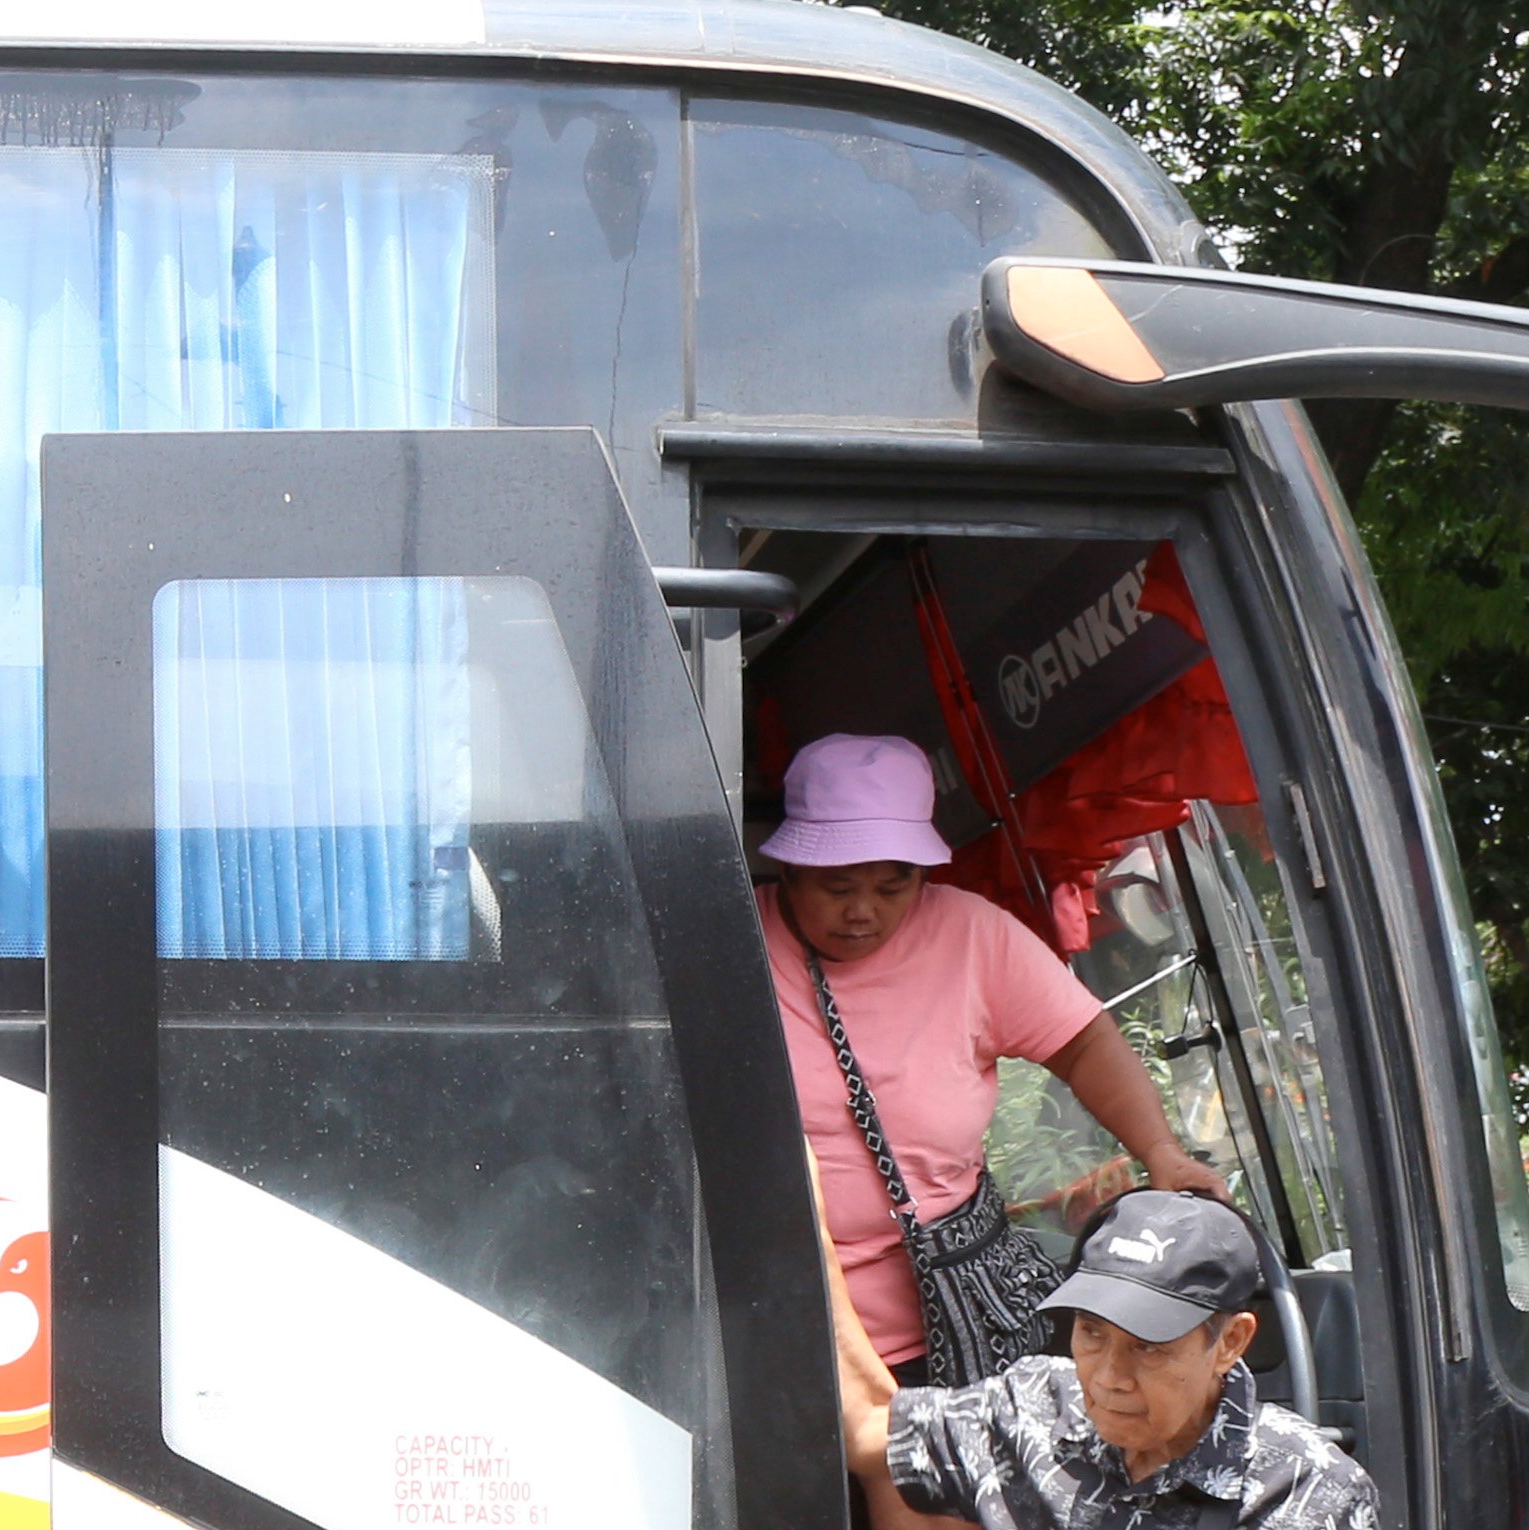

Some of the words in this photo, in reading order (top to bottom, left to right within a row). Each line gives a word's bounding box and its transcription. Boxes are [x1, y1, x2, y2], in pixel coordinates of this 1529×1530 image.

[395, 1435, 495, 1456] CAPACITY
[463, 1457, 510, 1478] HMTI
[394, 1480, 423, 1501] GR
[477, 1481, 532, 1502] 15000
[394, 1503, 457, 1524] TOTAL
[529, 1505, 549, 1525] 61
